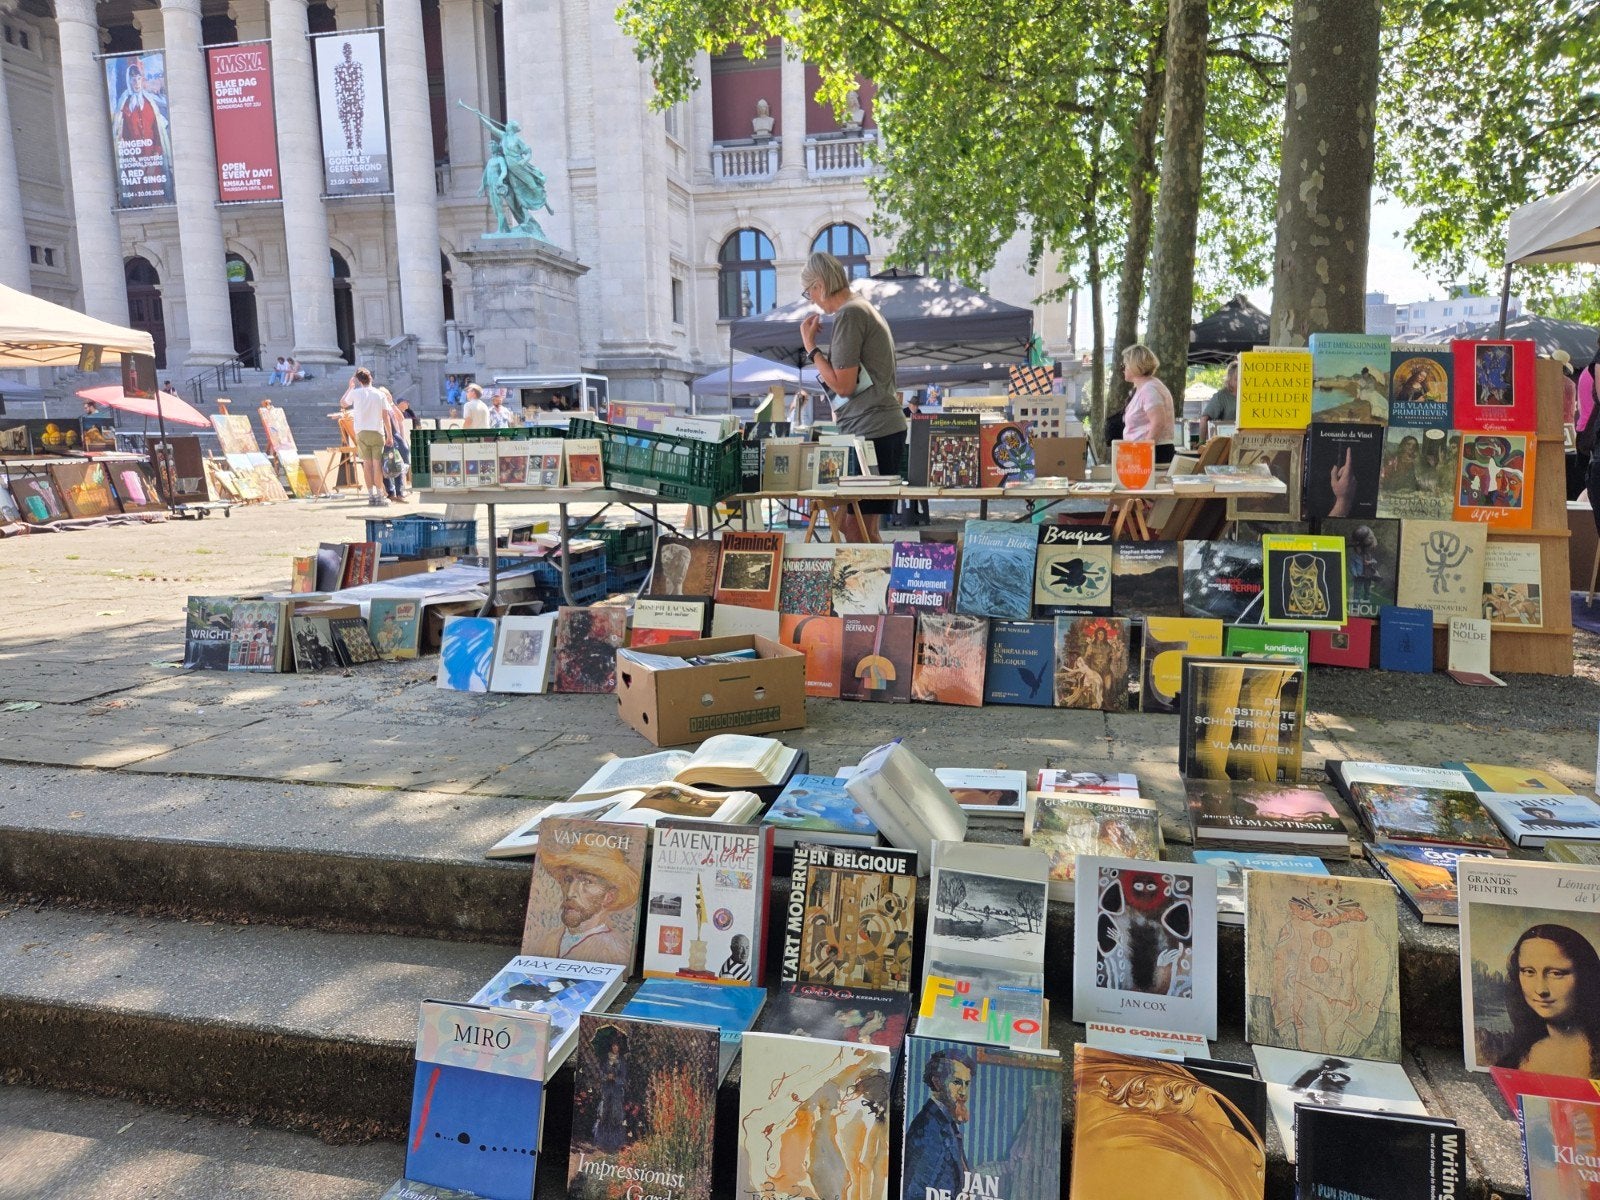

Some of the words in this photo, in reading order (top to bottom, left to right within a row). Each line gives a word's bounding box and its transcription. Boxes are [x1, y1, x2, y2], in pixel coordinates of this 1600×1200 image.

[215, 79, 237, 90] ELKE
[238, 77, 258, 87] DAG
[215, 86, 242, 97] OPEN!
[238, 95, 255, 103] LAAT
[118, 138, 153, 149] ZINGEND
[118, 147, 142, 157] ROOD
[329, 155, 371, 166] GORMLEY
[222, 162, 246, 172] OPEN
[329, 163, 382, 173] GEESTGROND
[128, 169, 145, 178] RED
[222, 169, 251, 180] EVERY
[252, 168, 273, 178] DAY!
[121, 177, 142, 186] THAT
[143, 174, 167, 184] SINGS
[245, 178, 261, 186] LATE
[1243, 362, 1310, 373] MODERNE
[1243, 377, 1310, 388] VLAAMSE
[1242, 392, 1310, 403] SCHILDER
[1393, 402, 1406, 410] DE
[1407, 402, 1447, 410] VLAAMSE
[1252, 408, 1300, 419] KUNST
[1392, 409, 1448, 417] PRIMITIEVEN
[1320, 430, 1348, 438] Leonardo
[1357, 431, 1373, 439] Vinci
[722, 534, 779, 551] Vlaminck
[968, 534, 1004, 547] William
[1006, 537, 1032, 549] Blake
[1043, 525, 1110, 550] Braque
[895, 552, 933, 570] histoire
[907, 578, 947, 590] mouvement
[1231, 583, 1261, 593] PERRIN
[890, 589, 943, 607] surréaliste
[845, 624, 876, 633] BERTRAND
[1452, 621, 1478, 631] EMIL
[190, 628, 230, 639] WRIGHT
[1452, 630, 1487, 641] NOLDE
[1264, 643, 1305, 654] kandinsky
[993, 658, 1026, 666] BELGIQUE
[1264, 698, 1281, 706] DE
[1224, 706, 1296, 720] ABSTRACTE
[1194, 715, 1295, 732] SCHILDERKUNST
[1266, 733, 1278, 742] IN
[1212, 740, 1294, 756] VLAANDEREN
[1044, 798, 1094, 810] GUSTAVE
[1101, 804, 1151, 816] MOREAU
[553, 829, 583, 845] VAN
[584, 833, 631, 850] GOGH
[659, 826, 756, 854] L'AVENTURE
[809, 850, 828, 866] EN
[834, 852, 906, 874] BELGIQUE
[1245, 859, 1313, 868] Jongkind
[1467, 874, 1511, 886] GRANDS
[789, 848, 809, 933] MODERNE
[1468, 884, 1518, 896] PEINTRES
[1575, 892, 1588, 903] de
[782, 934, 801, 983] L'ART
[513, 959, 553, 970] MAX
[555, 963, 617, 976] ERNST
[855, 994, 893, 1002] KEERPUNT
[1120, 998, 1140, 1008] JAN
[1143, 1001, 1167, 1012] COX
[453, 1022, 511, 1050] MIRÓ
[1089, 1023, 1126, 1034] JULIO
[1129, 1028, 1204, 1043] GONZALEZ
[578, 1152, 685, 1188] Impressionist
[962, 1171, 999, 1197] JAN
